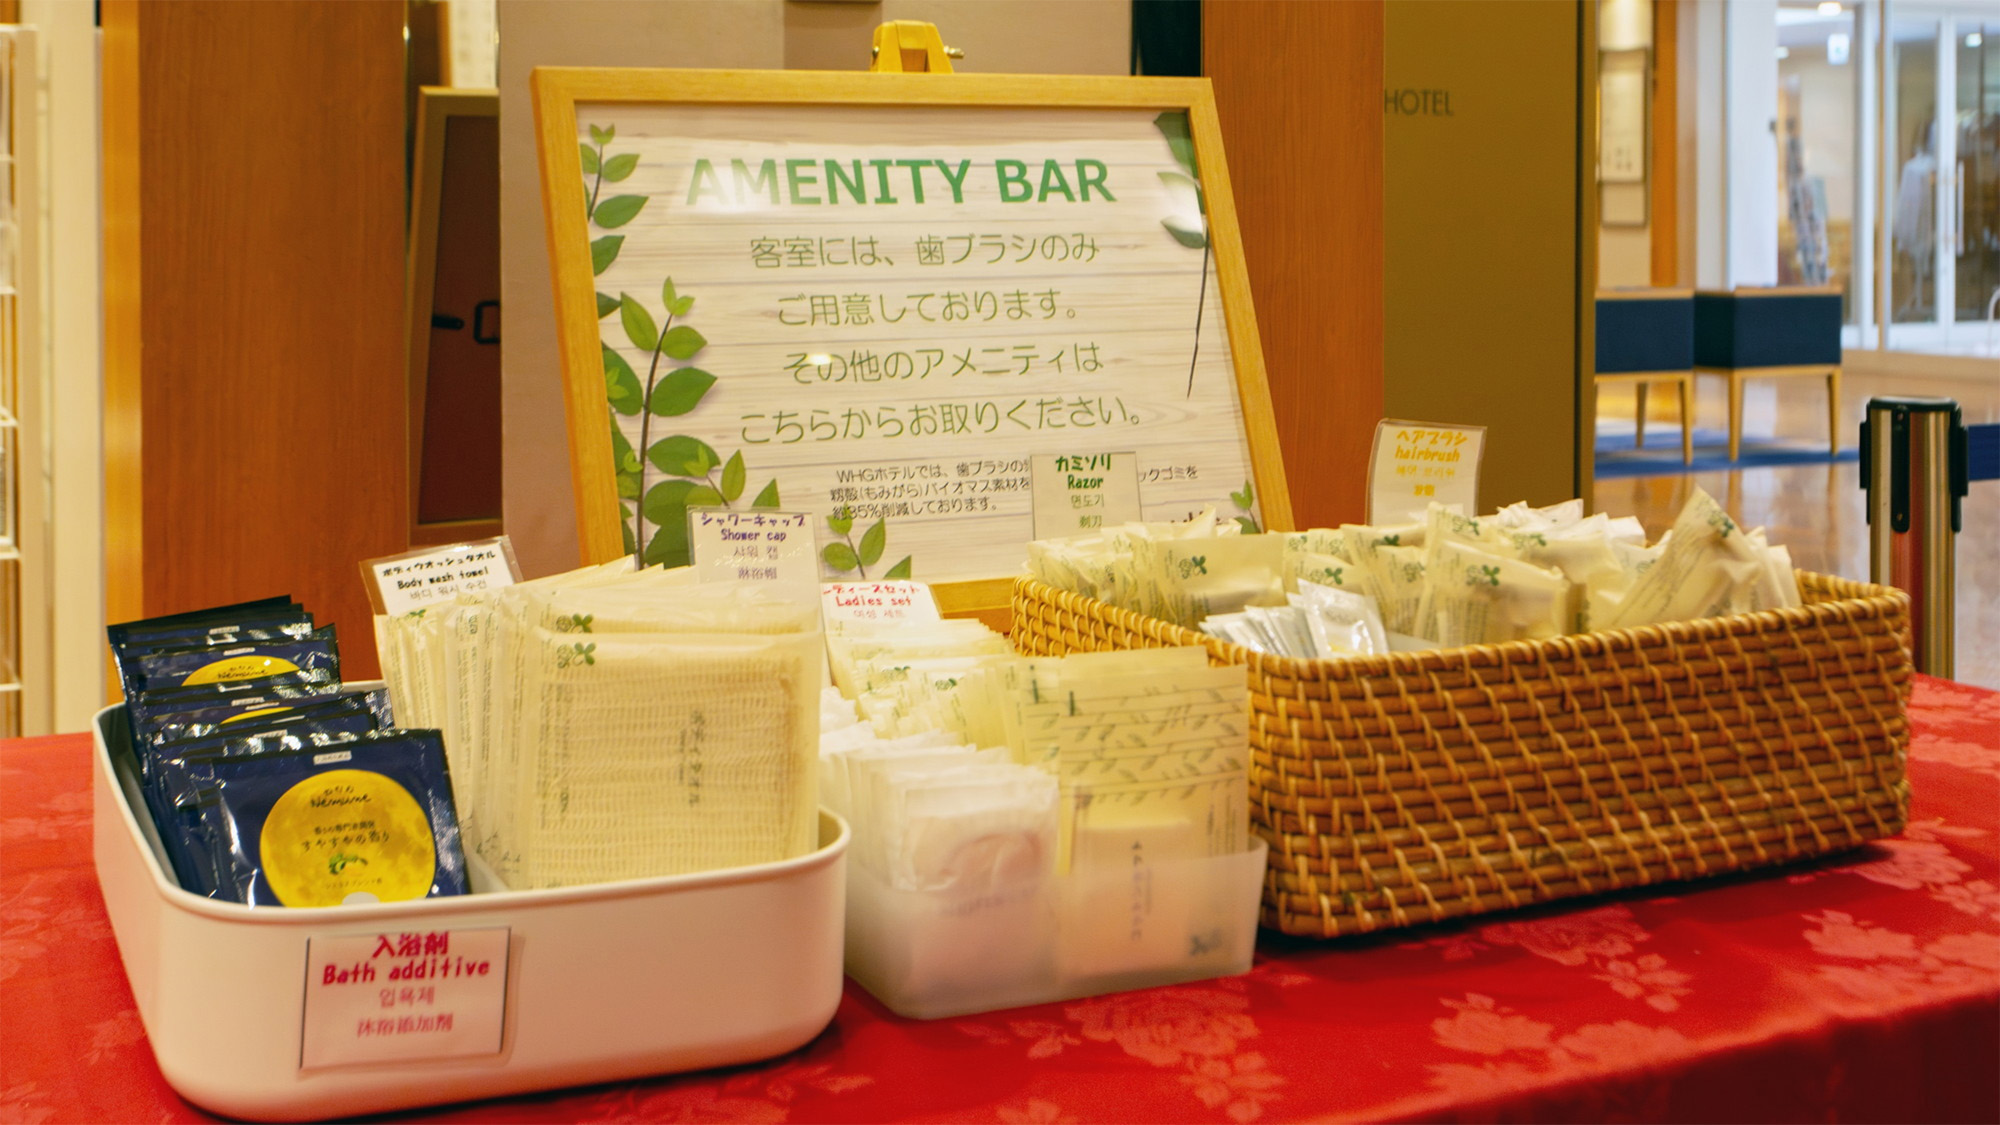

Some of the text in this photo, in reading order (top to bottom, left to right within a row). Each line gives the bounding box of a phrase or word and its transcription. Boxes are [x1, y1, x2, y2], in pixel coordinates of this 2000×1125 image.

[1384, 87, 1454, 116] HOTEL
[687, 158, 1118, 206] AMENITY BAR
[750, 233, 1100, 268] 客室には、歯ブラシのみ
[778, 288, 1077, 326] ご用意しております。
[783, 341, 1104, 384] その他のアメニティは
[741, 396, 1142, 444] こちらからお取りください。
[1396, 430, 1468, 446] ヘアブラシ
[1055, 453, 1111, 472] カミソリ
[1395, 444, 1460, 462] hairbrush
[1067, 474, 1104, 489] Razor
[701, 512, 805, 527] シャワーキャップ
[721, 528, 787, 542] Shower cap
[397, 566, 489, 590] Body wash towel
[835, 595, 912, 607] Ladies set
[372, 931, 449, 959] 入浴剤
[322, 956, 490, 985] Bath additive
